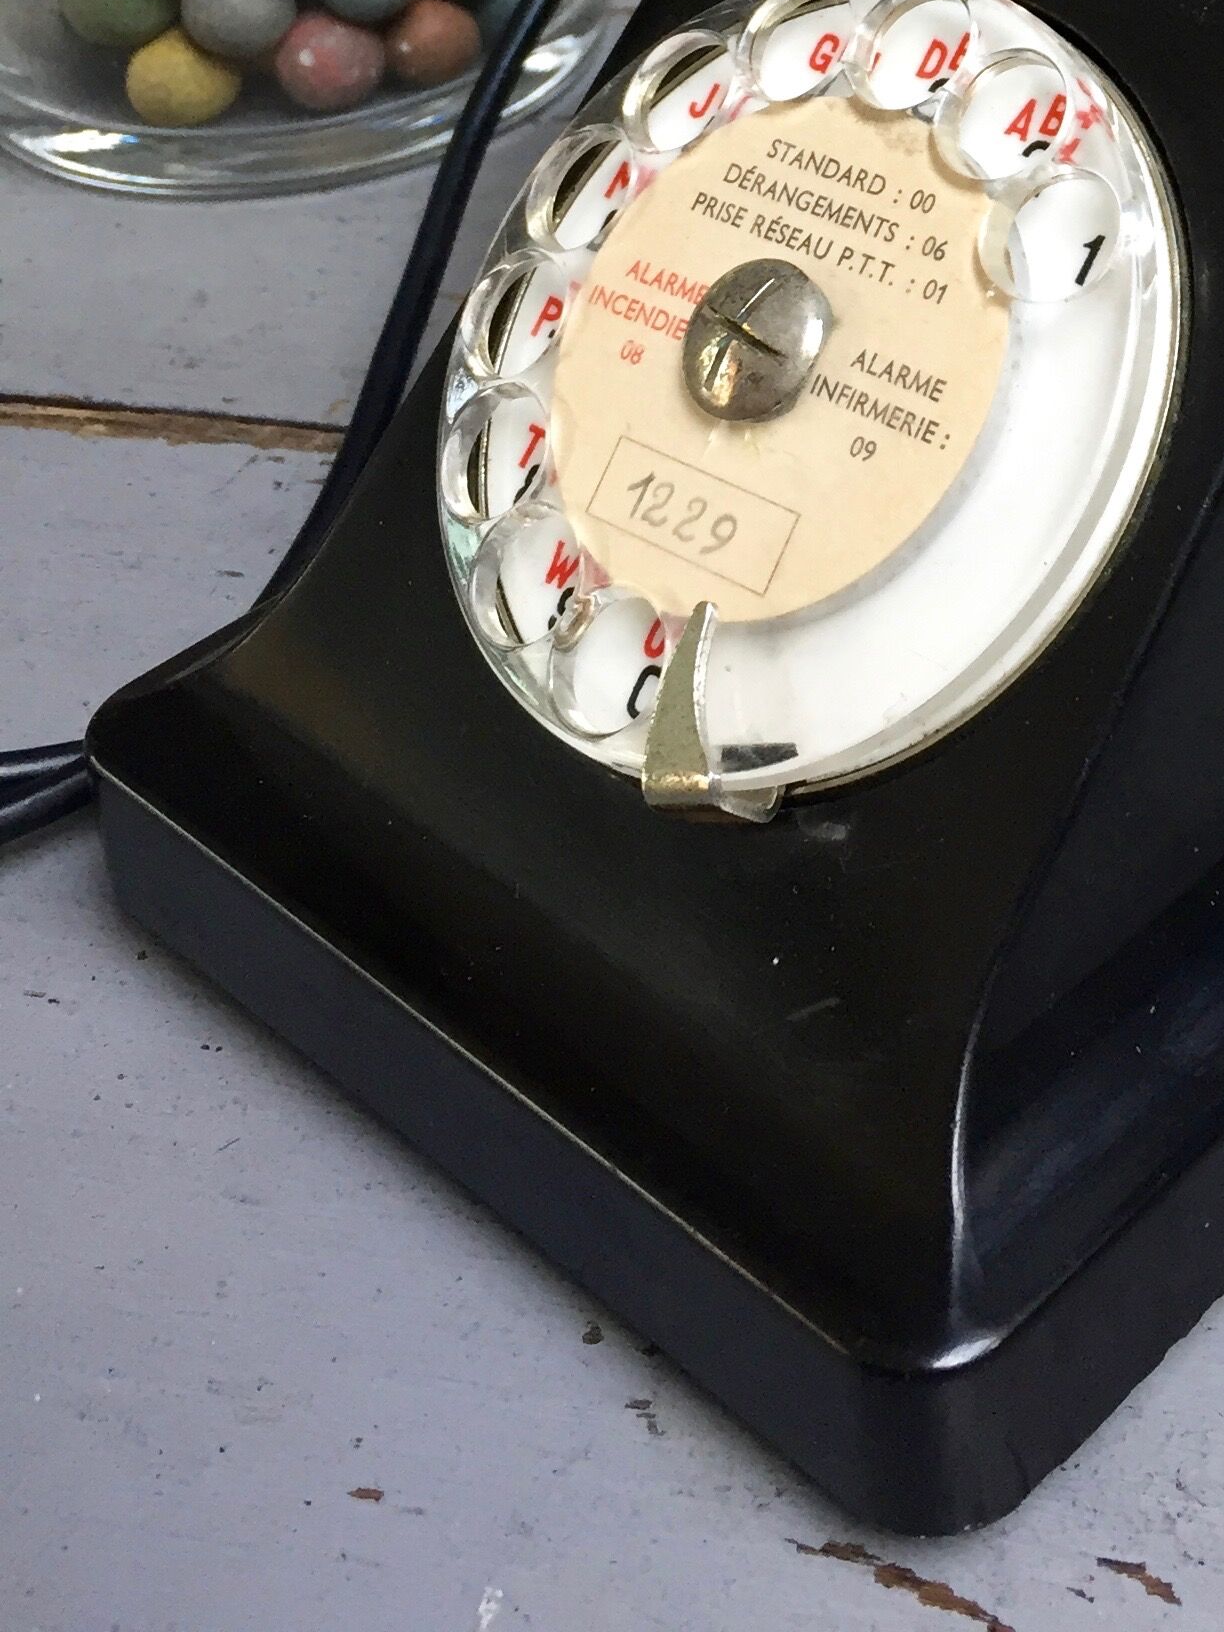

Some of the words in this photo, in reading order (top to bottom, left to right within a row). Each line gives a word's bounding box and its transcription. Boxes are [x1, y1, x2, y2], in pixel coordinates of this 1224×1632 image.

[766, 138, 887, 196] STANDARD
[909, 189, 937, 215] 00
[723, 163, 900, 243] DÉRANGEMENTS
[921, 236, 949, 262] 06
[690, 191, 748, 229] PRISE
[749, 214, 834, 260] RÉSEAU
[922, 279, 949, 306] 01
[1074, 235, 1106, 287] 1
[625, 259, 710, 305] ALARME
[588, 284, 689, 341] INCENDIE
[619, 339, 645, 366] 08
[850, 348, 948, 403] ALARME
[849, 436, 878, 462] 09
[626, 471, 738, 555] 1229
